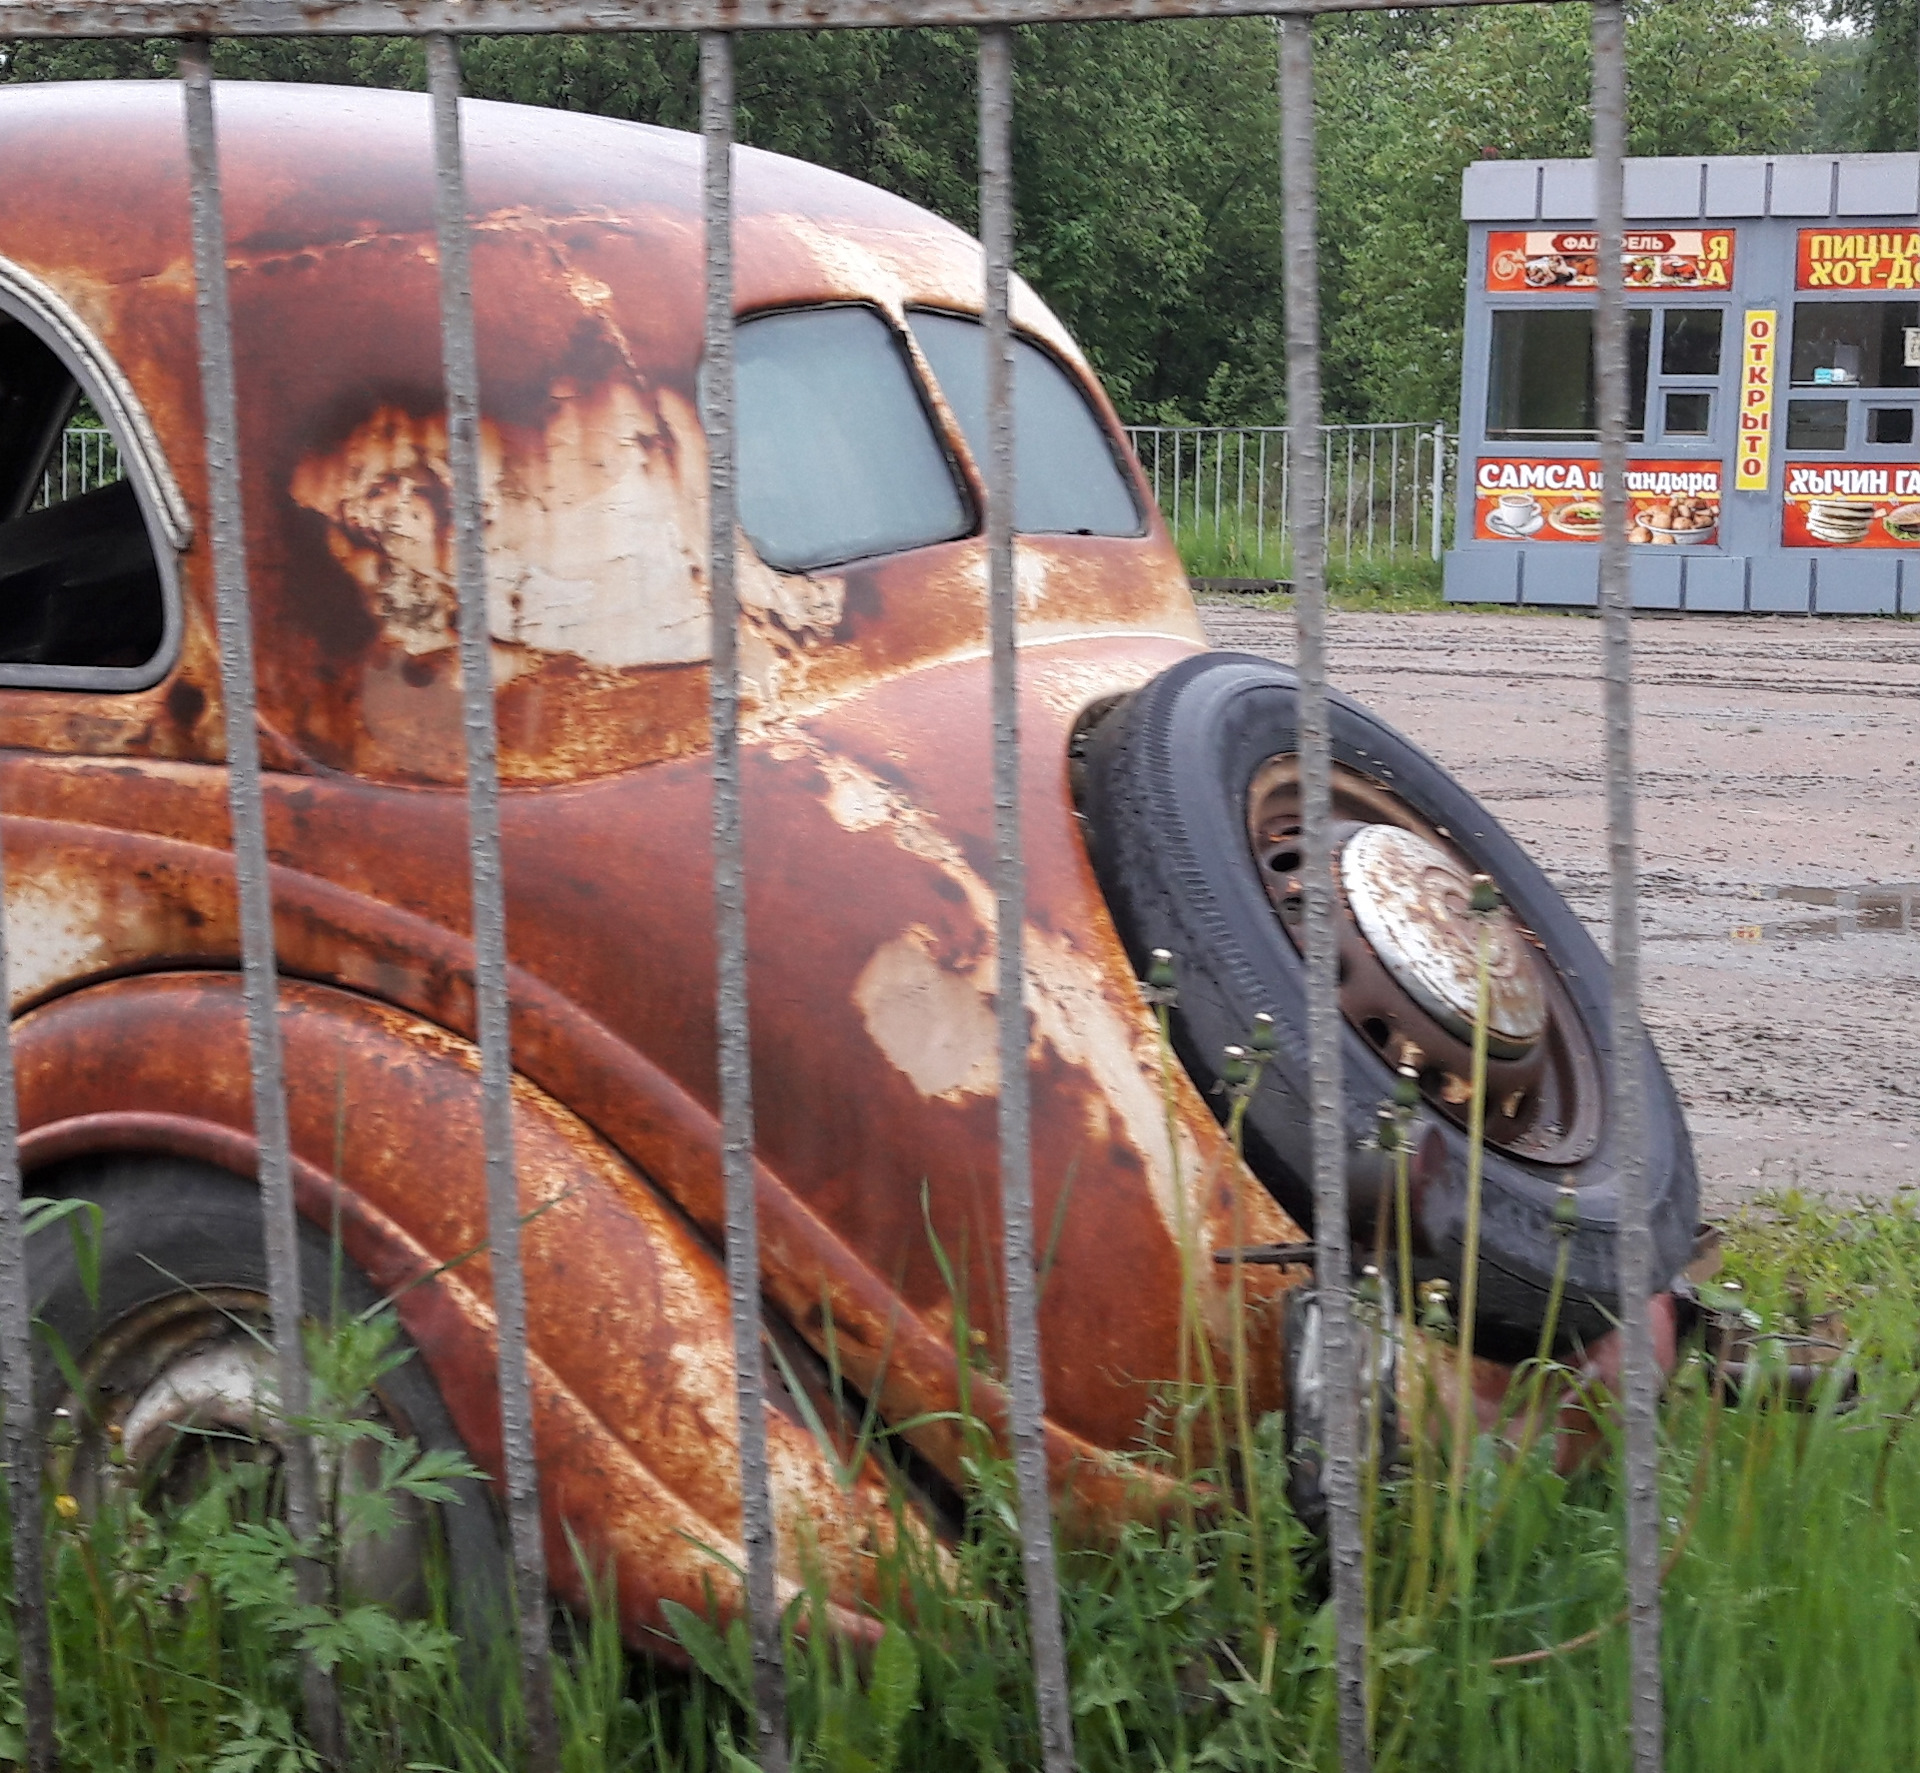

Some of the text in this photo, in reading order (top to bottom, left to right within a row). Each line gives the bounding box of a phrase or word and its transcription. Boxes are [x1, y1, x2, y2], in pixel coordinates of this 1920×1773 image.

[1562, 236, 1664, 251] ФАЛЕЛЬ
[1810, 233, 1920, 265] ПИЦЦА
[1808, 259, 1920, 289] ХОТ-Д
[1741, 320, 1769, 476] ОТКРЫТО
[1478, 463, 1586, 489] САМСА
[1789, 468, 1888, 494] ХЫЧИН
